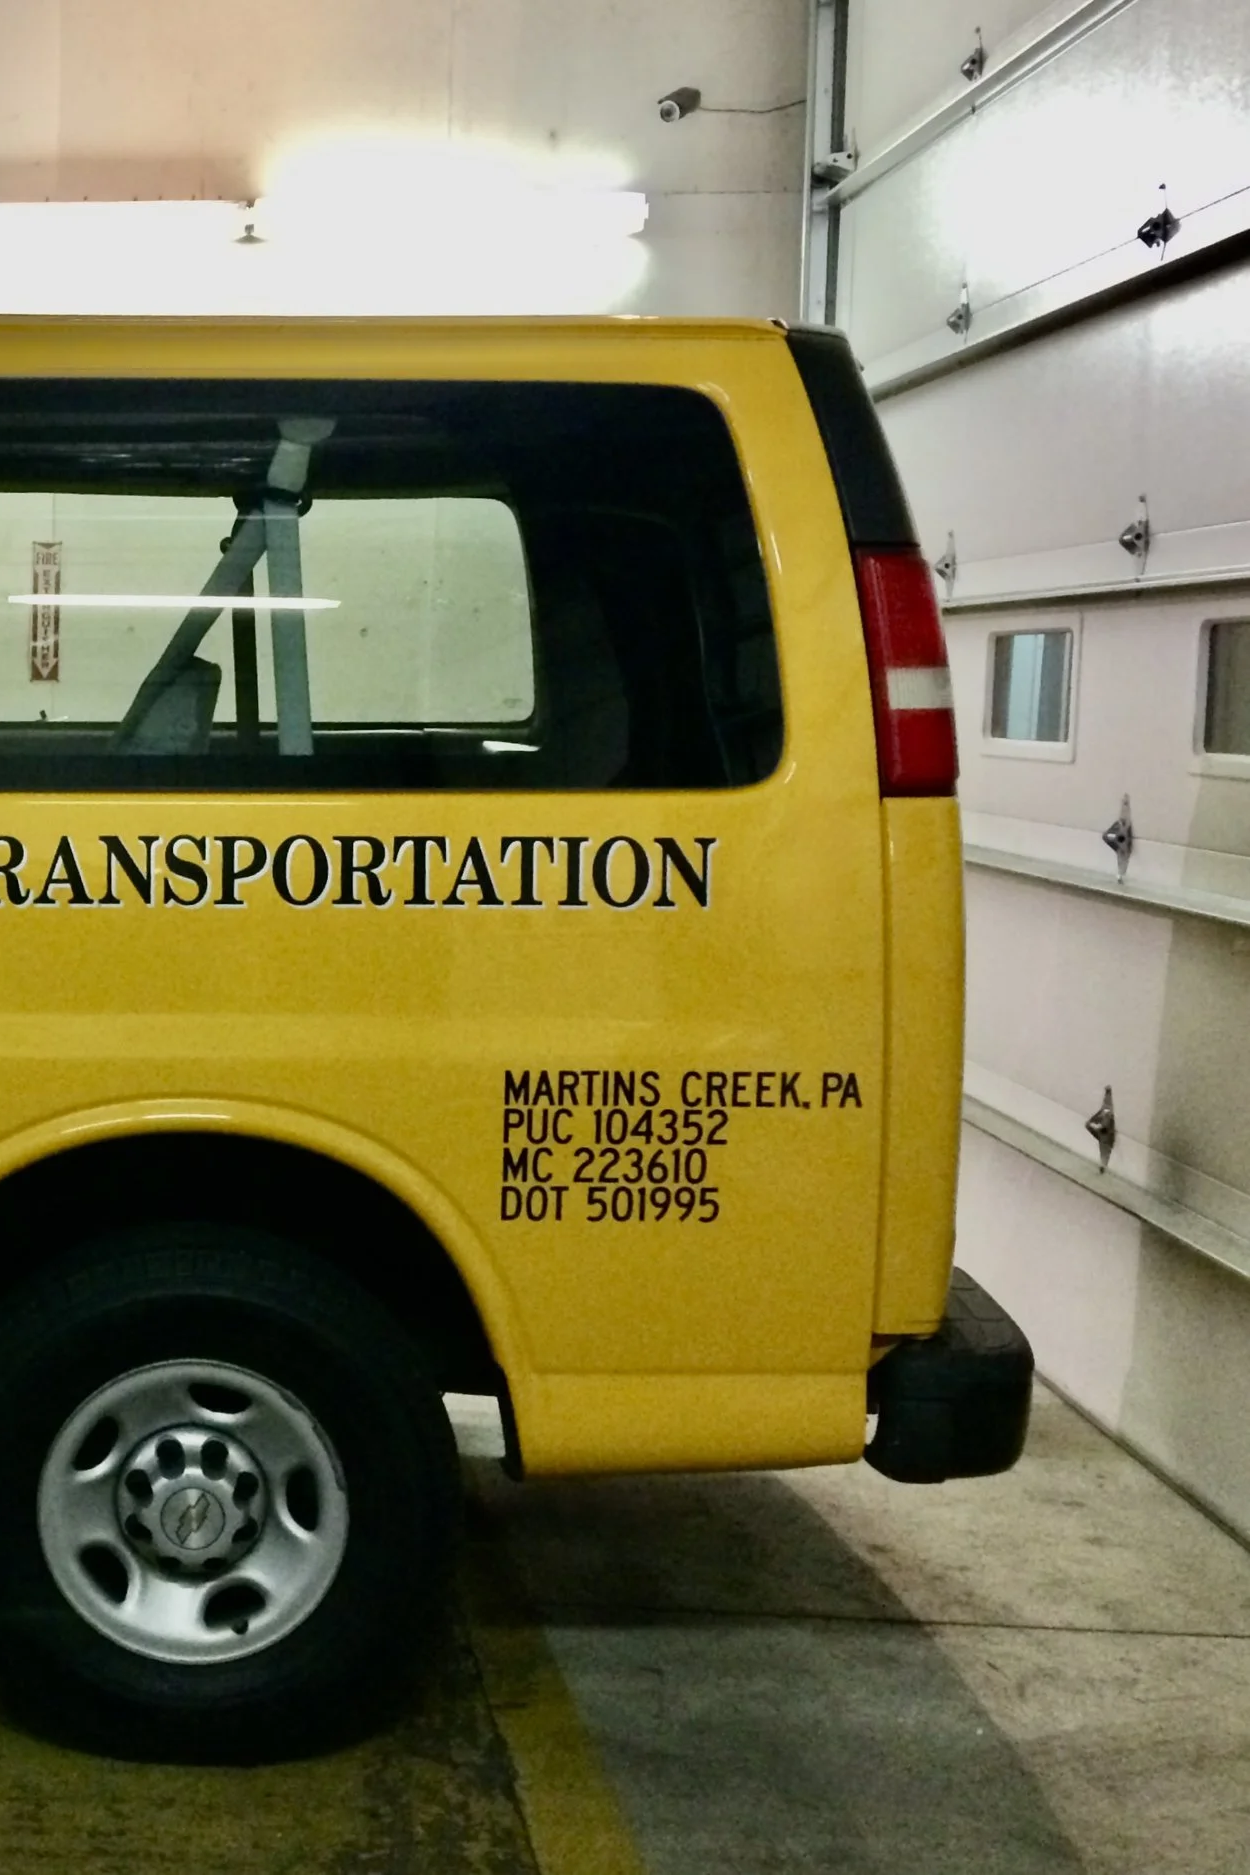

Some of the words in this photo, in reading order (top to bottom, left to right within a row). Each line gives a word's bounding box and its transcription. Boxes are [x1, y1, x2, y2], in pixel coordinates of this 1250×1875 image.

[36, 552, 59, 566] FIRE
[504, 1070, 661, 1107] MARTINS
[821, 1072, 863, 1109] PA
[503, 1108, 574, 1145] PUC
[594, 1109, 729, 1146] 104352
[502, 1147, 554, 1183] MC
[573, 1147, 708, 1184] 223610
[500, 1186, 569, 1222] DOT
[586, 1186, 720, 1223] 501995
